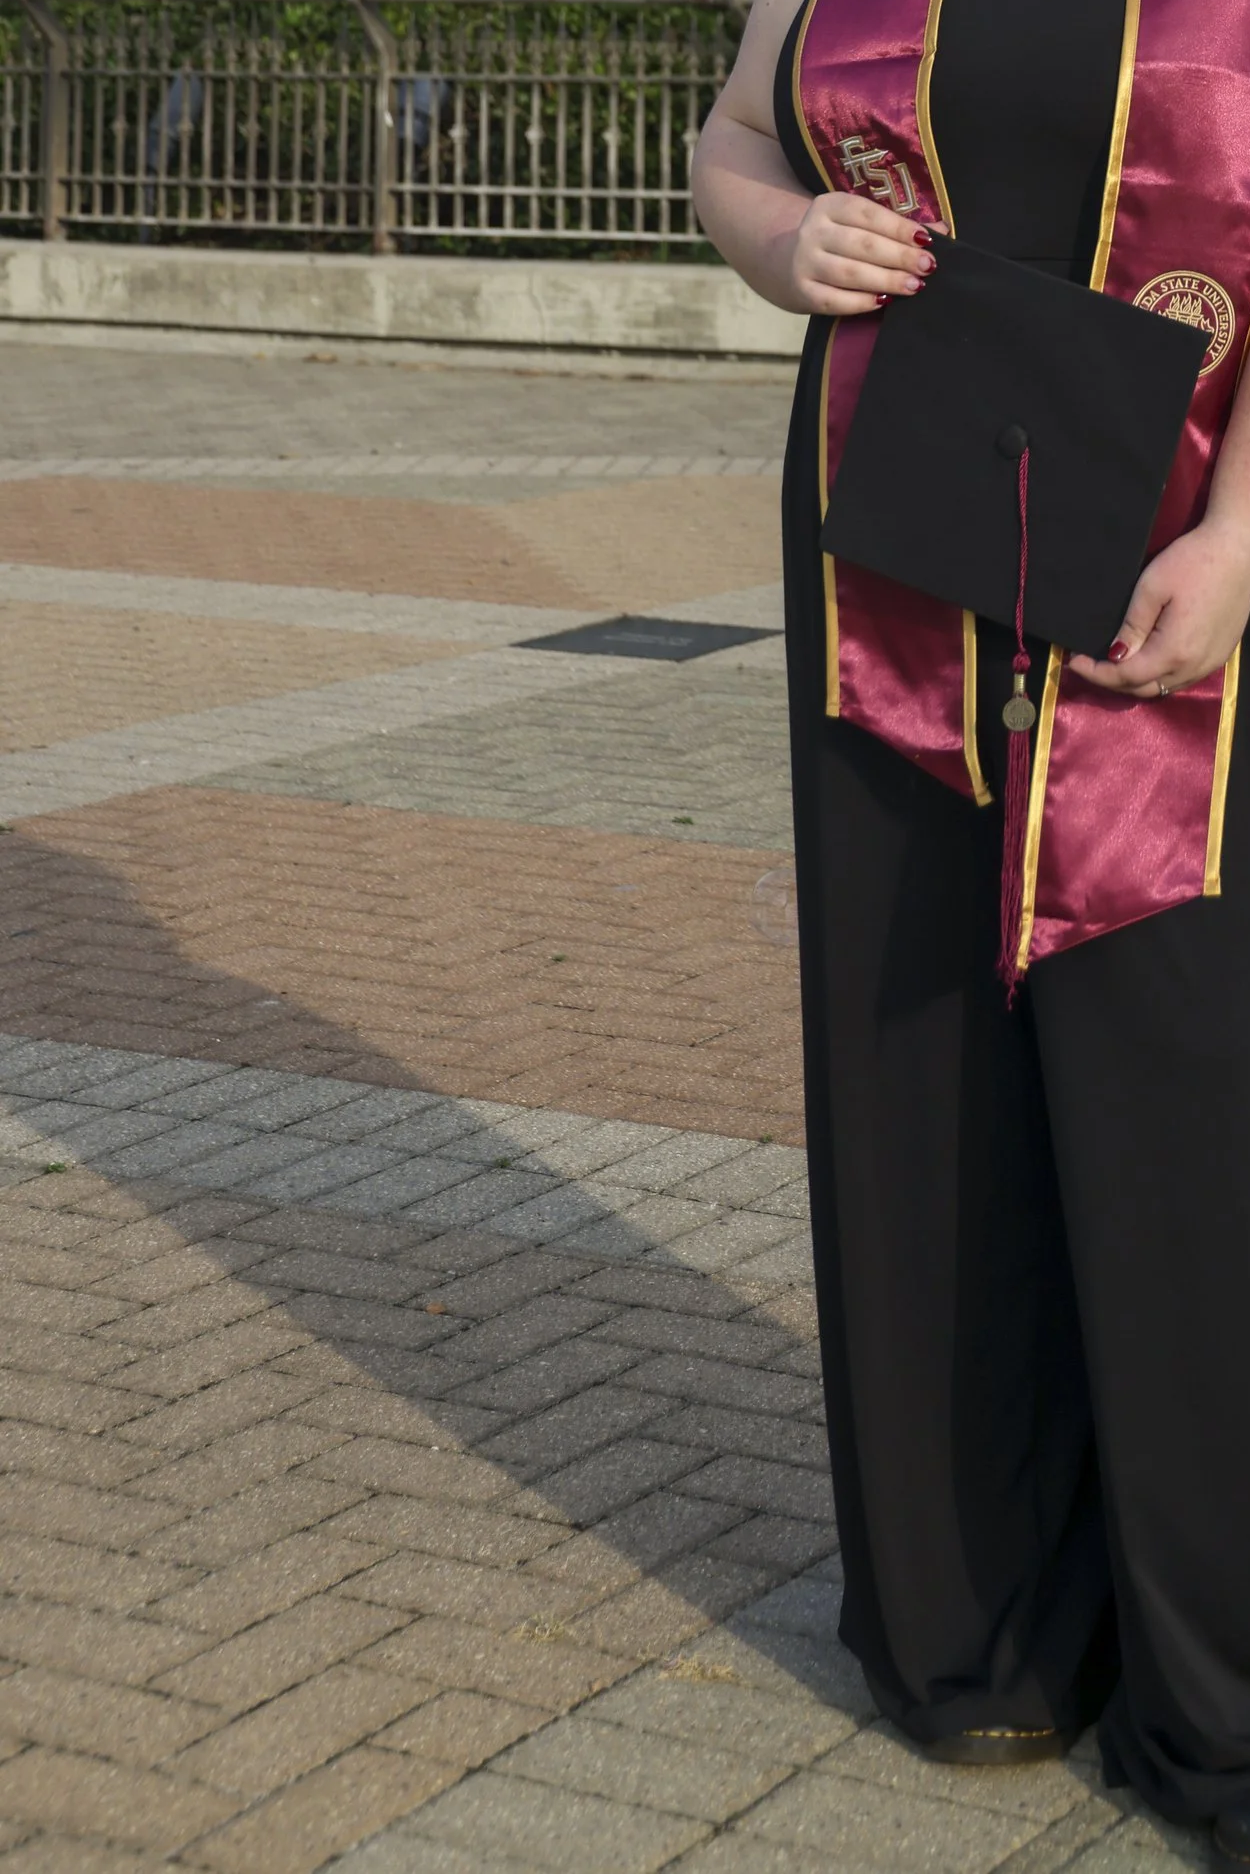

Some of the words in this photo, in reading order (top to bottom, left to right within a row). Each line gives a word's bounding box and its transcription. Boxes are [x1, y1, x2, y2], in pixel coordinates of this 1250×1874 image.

[836, 135, 920, 214] FSU
[1160, 277, 1200, 292] STATE
[1202, 284, 1229, 361] UNIVERSITY
